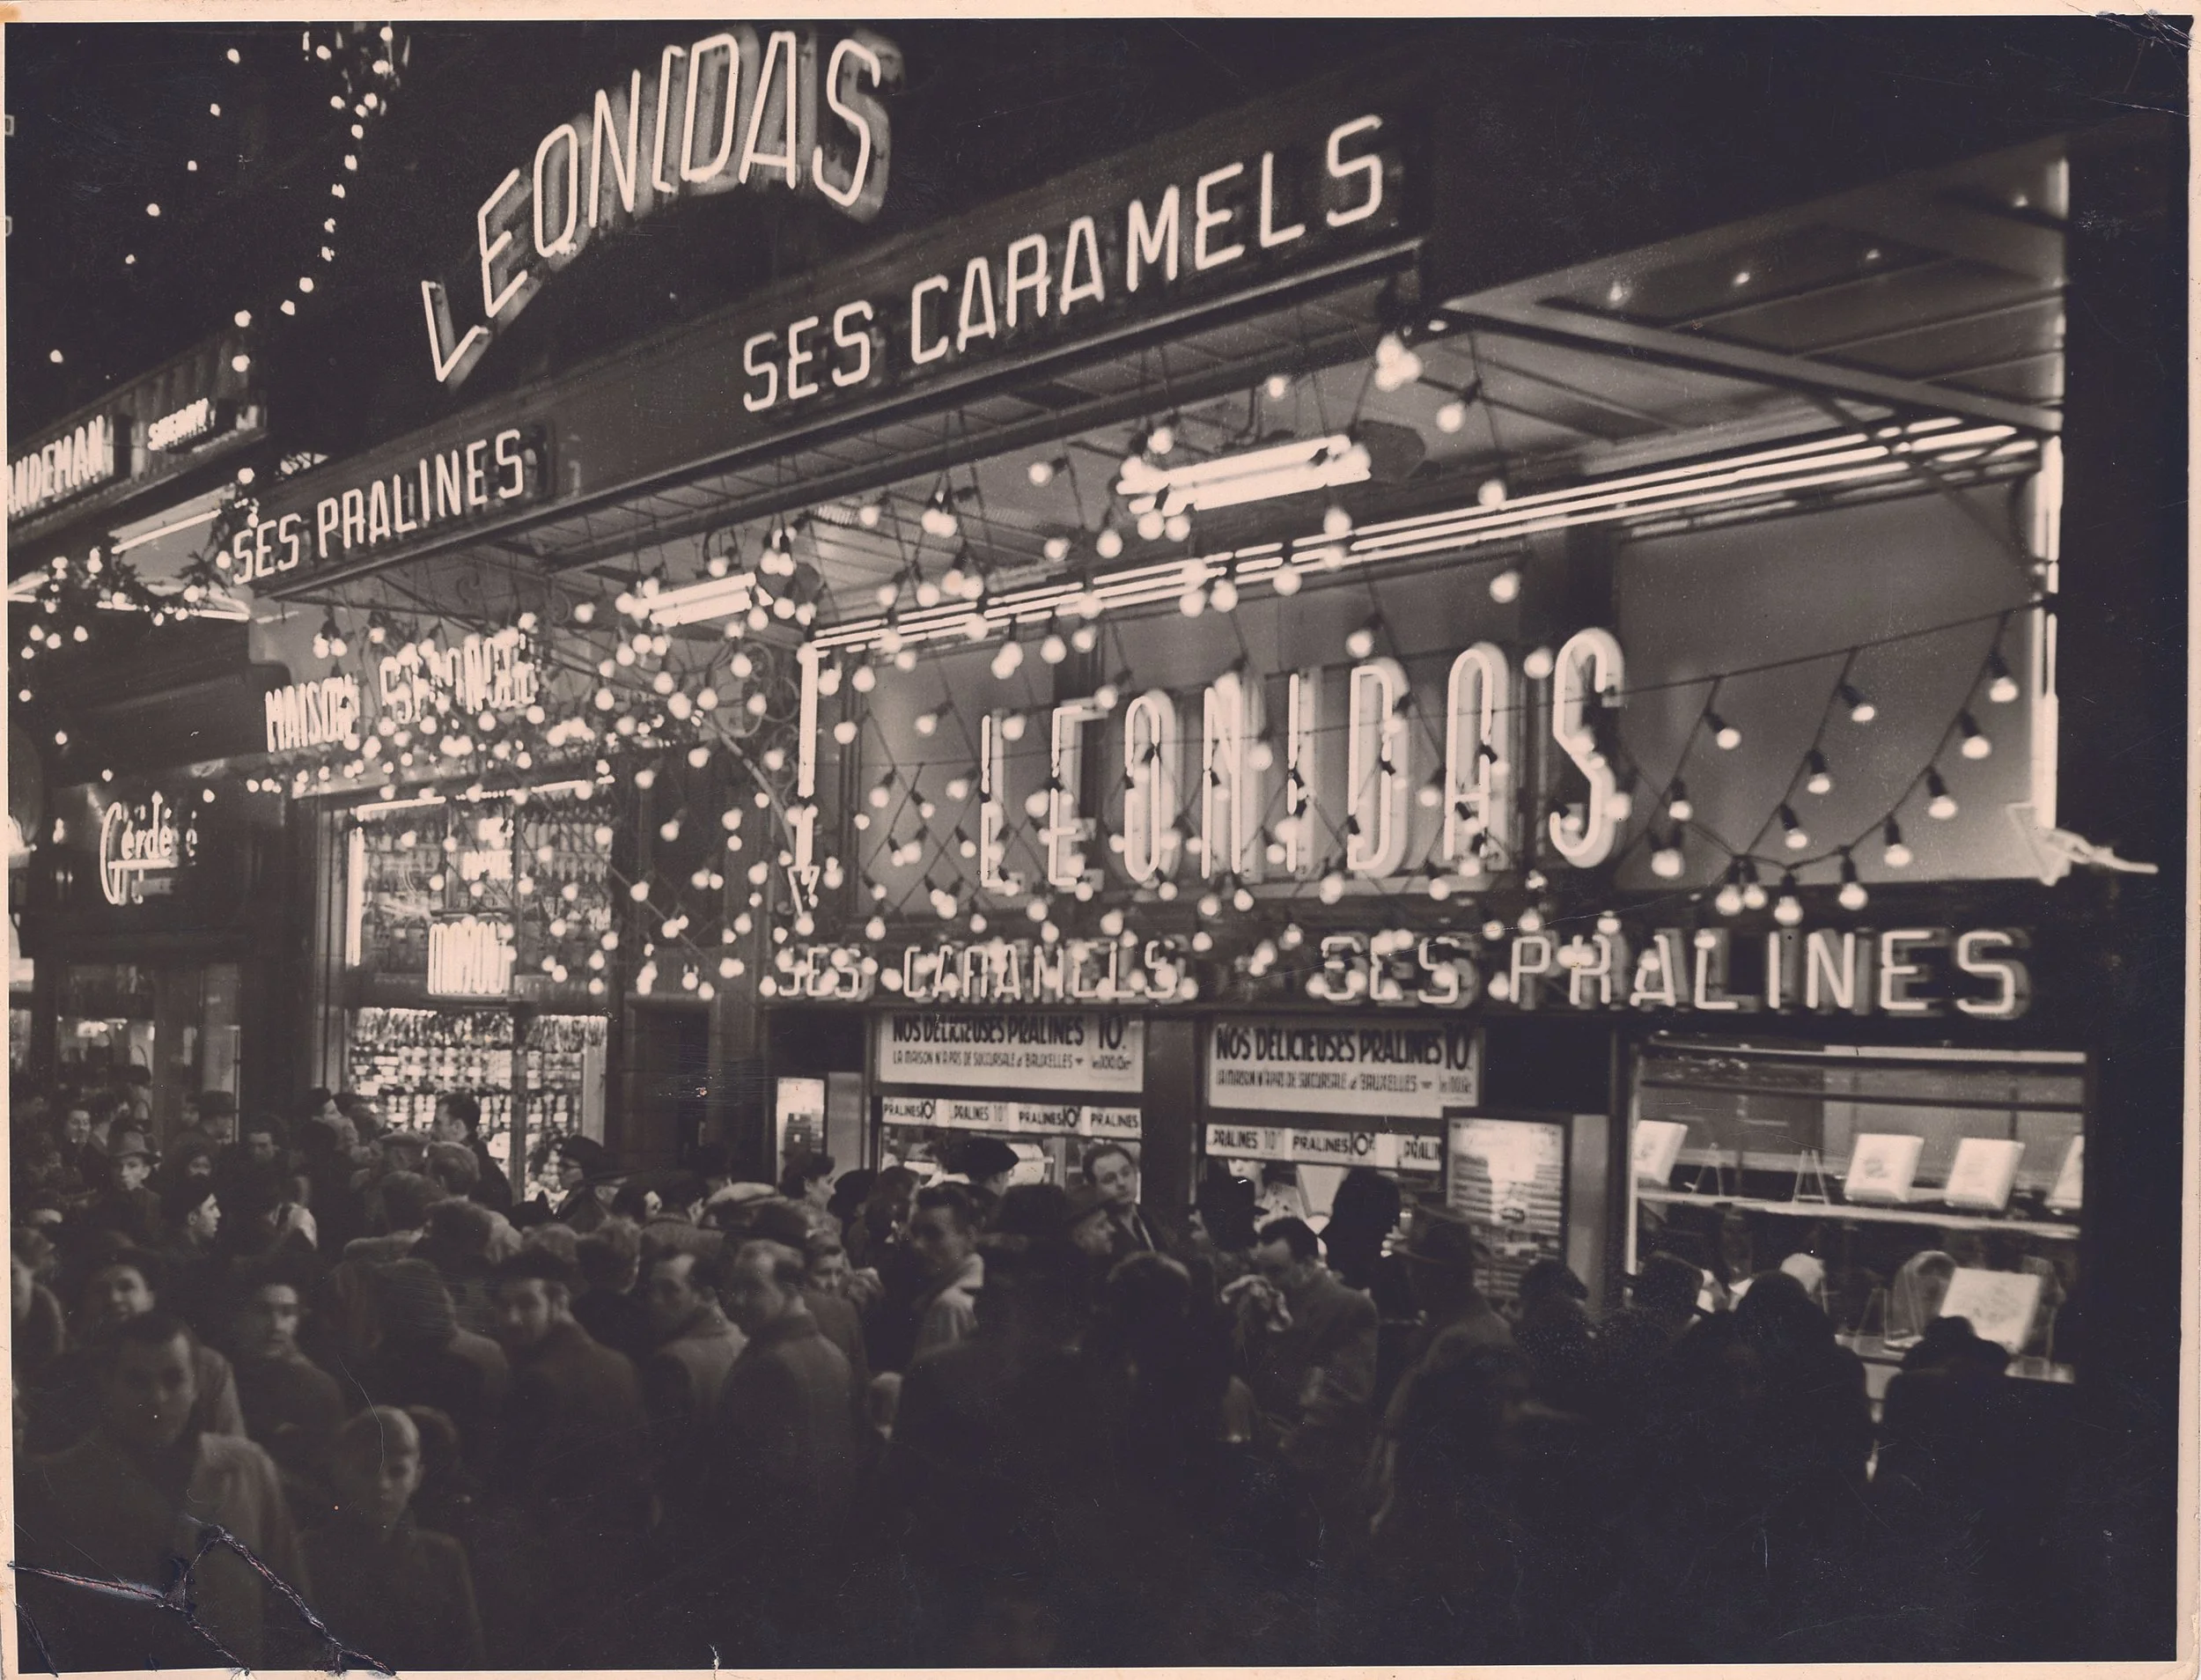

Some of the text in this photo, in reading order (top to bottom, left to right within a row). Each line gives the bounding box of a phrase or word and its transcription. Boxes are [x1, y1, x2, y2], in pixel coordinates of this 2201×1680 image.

[421, 31, 887, 383] LEONIDAS
[743, 114, 1383, 412] SES CARAMELS
[232, 429, 525, 586] SES PRALINES
[980, 629, 1623, 889] LEONIDAS
[778, 940, 1178, 999] SES CARAMELS
[1320, 929, 2021, 1016] SES PRALINES
[1007, 1014, 1084, 1046] PRALINES
[1217, 1027, 1251, 1060] NOS
[1358, 1028, 1442, 1065] PRALINES
[1019, 1111, 1064, 1127] PRALINES
[1091, 1113, 1138, 1128] PRALINES
[1293, 1135, 1350, 1153] PRALINES
